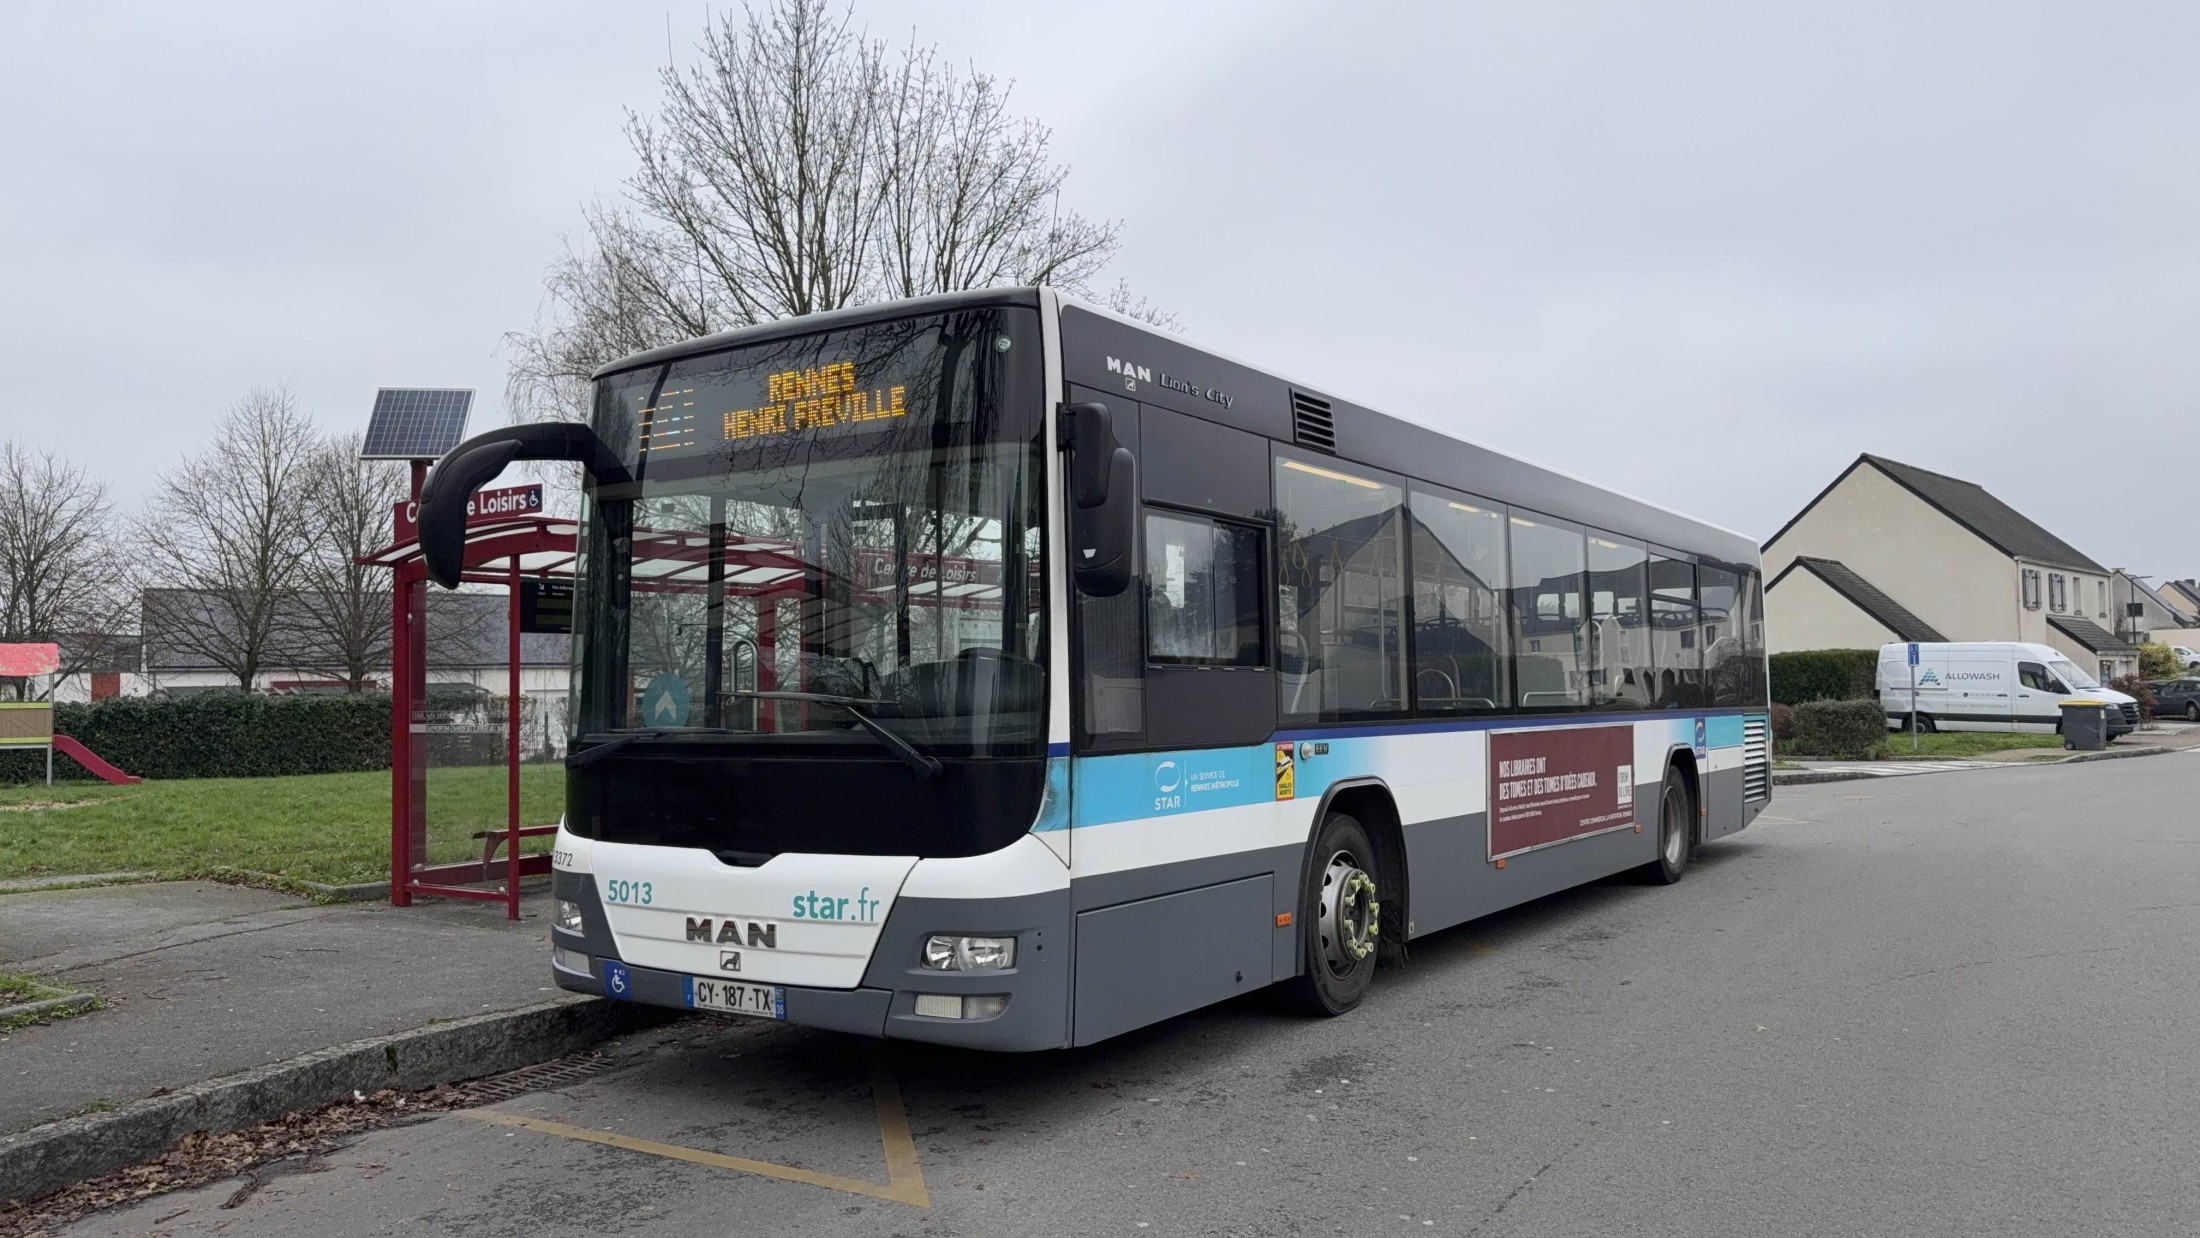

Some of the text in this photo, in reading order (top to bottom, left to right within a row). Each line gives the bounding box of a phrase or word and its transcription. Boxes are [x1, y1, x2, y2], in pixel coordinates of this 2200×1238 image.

[769, 362, 855, 402] RENNES
[1106, 355, 1233, 409] MAN Lion's City
[724, 404, 787, 440] HENRI
[794, 385, 905, 431] FREVILLE
[480, 489, 527, 515] Loisirs
[1945, 672, 2000, 681] ALLOWASH
[1315, 744, 1328, 754] EEV
[1190, 773, 1199, 782] UN
[1199, 770, 1218, 781] SERVICE
[1499, 757, 1546, 778] NOS LIBRAIRES ONT
[1190, 782, 1211, 793] RENNES
[1499, 782, 1510, 800] DES
[1510, 780, 1527, 799] TOMES
[1527, 779, 1534, 796] ET
[1534, 778, 1544, 795] DES
[1544, 775, 1560, 793] TOMES
[1154, 795, 1181, 811] STAR
[608, 879, 652, 905] 5013
[792, 887, 880, 922] star.fr
[686, 917, 778, 948] MAN
[776, 1003, 785, 1015] 35
